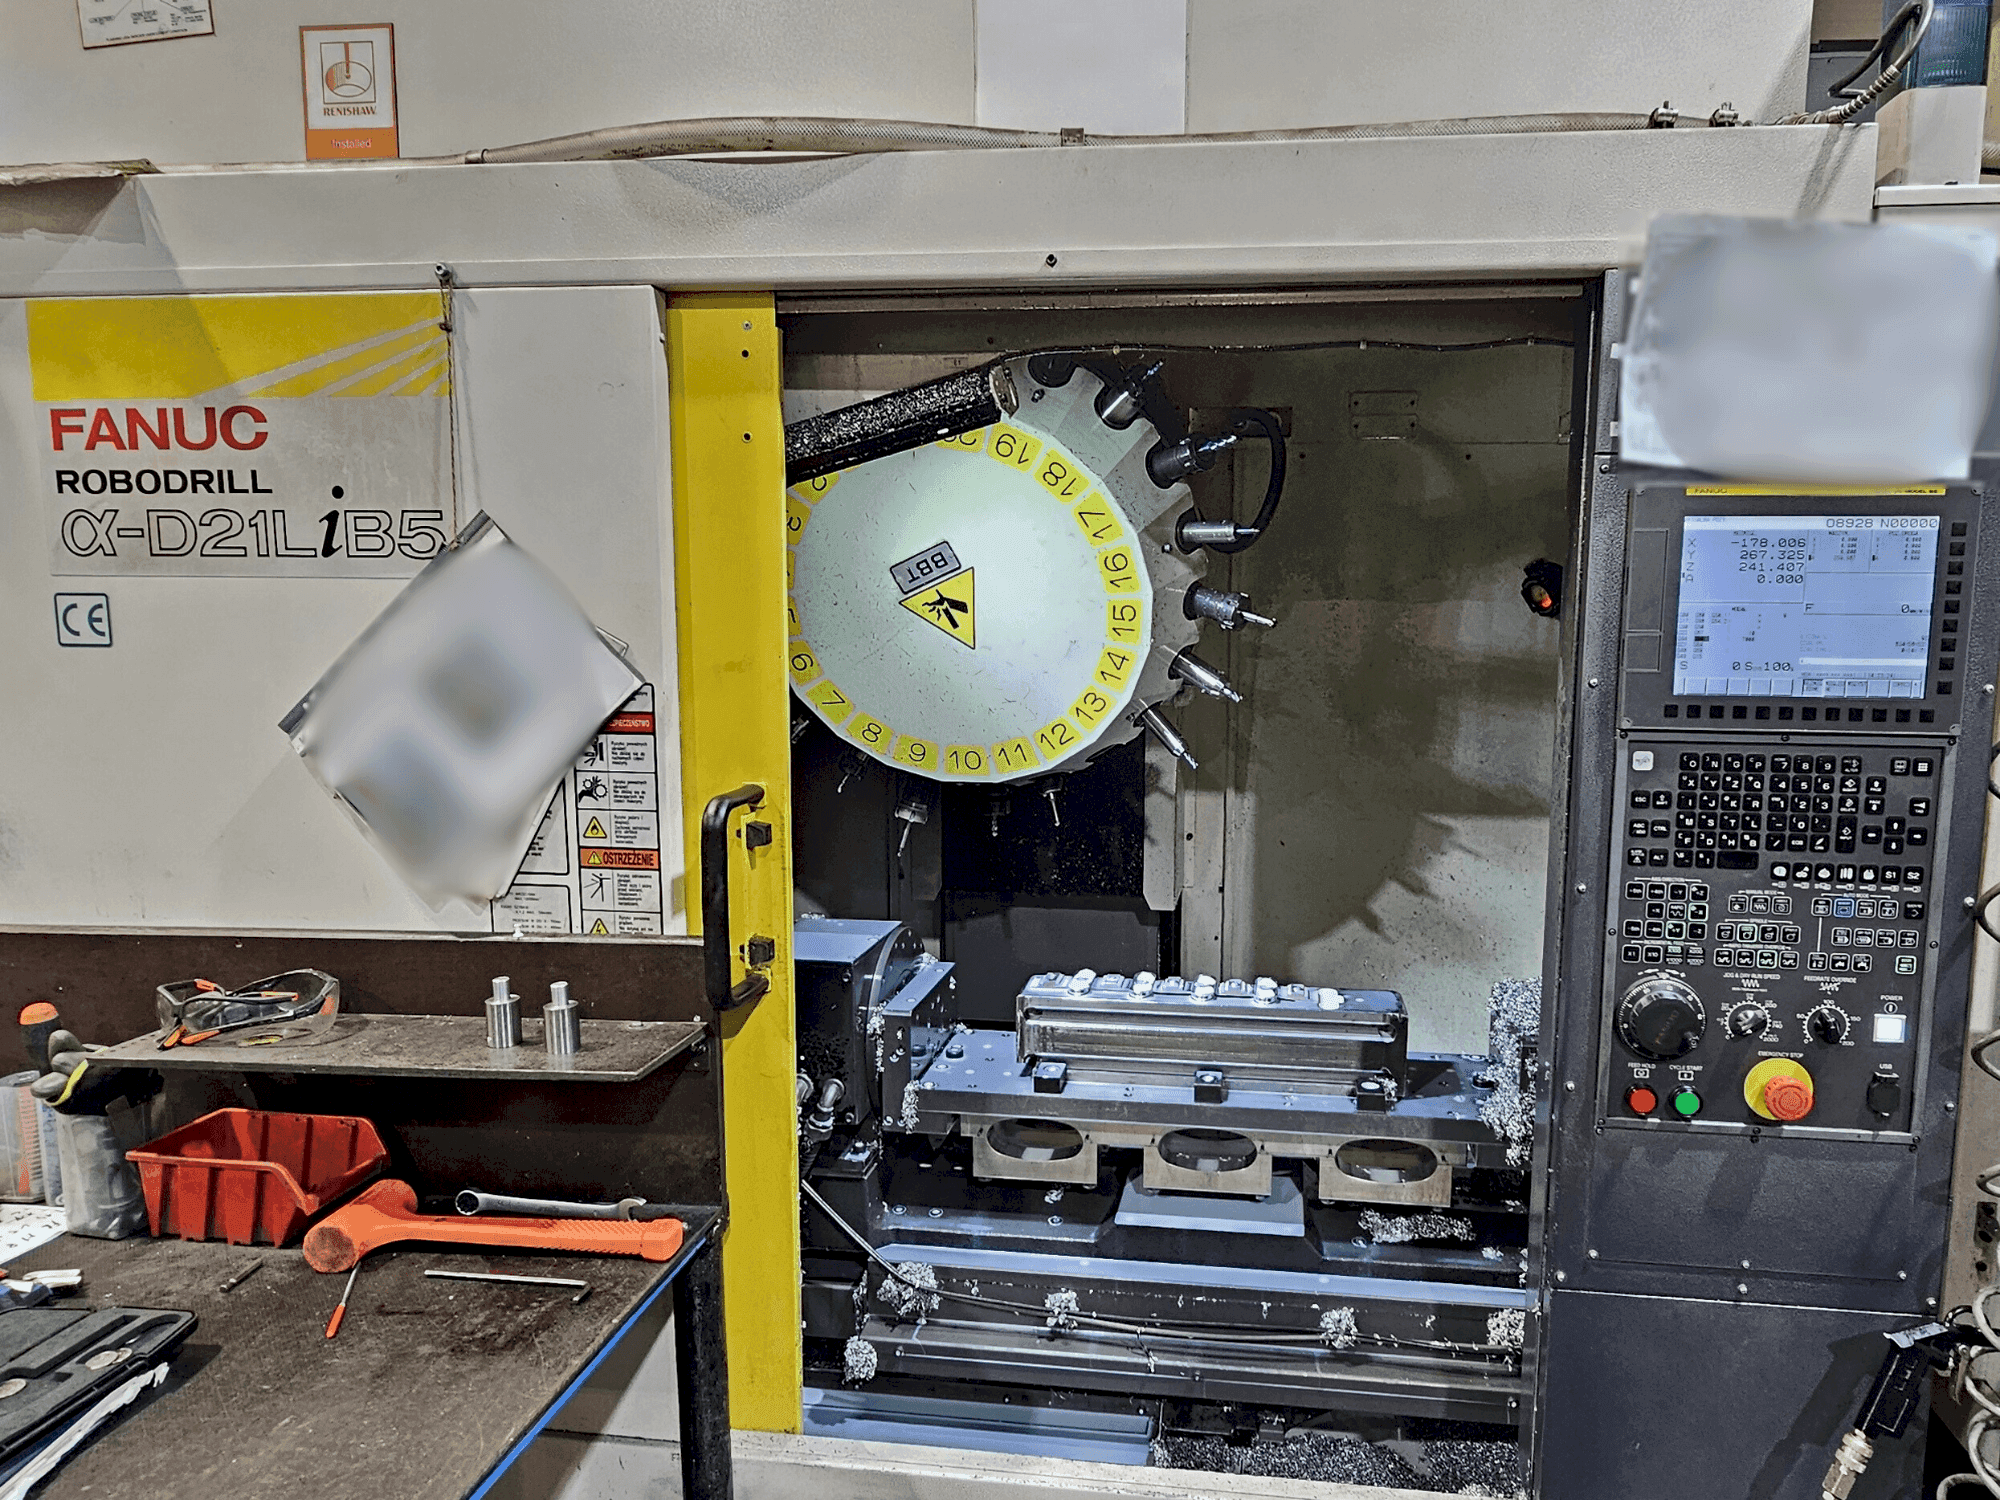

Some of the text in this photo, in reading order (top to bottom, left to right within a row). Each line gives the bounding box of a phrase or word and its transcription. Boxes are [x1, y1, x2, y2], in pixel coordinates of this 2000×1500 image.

[324, 106, 376, 116] RENISHAW
[50, 405, 268, 451] FANUC
[995, 432, 1030, 467] 19
[56, 469, 273, 494] ROBODRILL
[1042, 461, 1074, 497] 18
[1078, 511, 1114, 540] 17
[1880, 518, 1938, 528] N00000
[1688, 538, 1806, 547] X -178.006
[1688, 550, 1805, 560] Y 267.325
[907, 550, 949, 584] BBT
[1104, 552, 1133, 588] 16
[1687, 562, 1805, 572] Z 241.407
[1757, 574, 1804, 584] 0.000
[1805, 603, 1910, 613] F 0
[62, 603, 106, 636] CE
[1112, 603, 1137, 633] 15
[1100, 654, 1130, 682] 14
[1680, 661, 1688, 670] S
[1732, 661, 1740, 671] 0
[1745, 661, 1753, 671] S
[821, 690, 846, 708] 7
[1075, 691, 1107, 721] 13
[861, 722, 884, 743] 8
[1040, 722, 1075, 750] 12
[908, 743, 926, 763] 9
[949, 749, 982, 771] 10
[999, 747, 1026, 767] 11
[1802, 762, 1809, 770] 8
[1778, 781, 1786, 789] 4
[1780, 800, 1784, 808] 1
[1799, 801, 1807, 809] 2
[1821, 802, 1829, 810] 3
[1751, 820, 1758, 828] L
[1749, 839, 1757, 847] B
[603, 849, 654, 866] OSTRZEŻENIE
[1885, 871, 1896, 879] S1
[1907, 872, 1920, 880] S2
